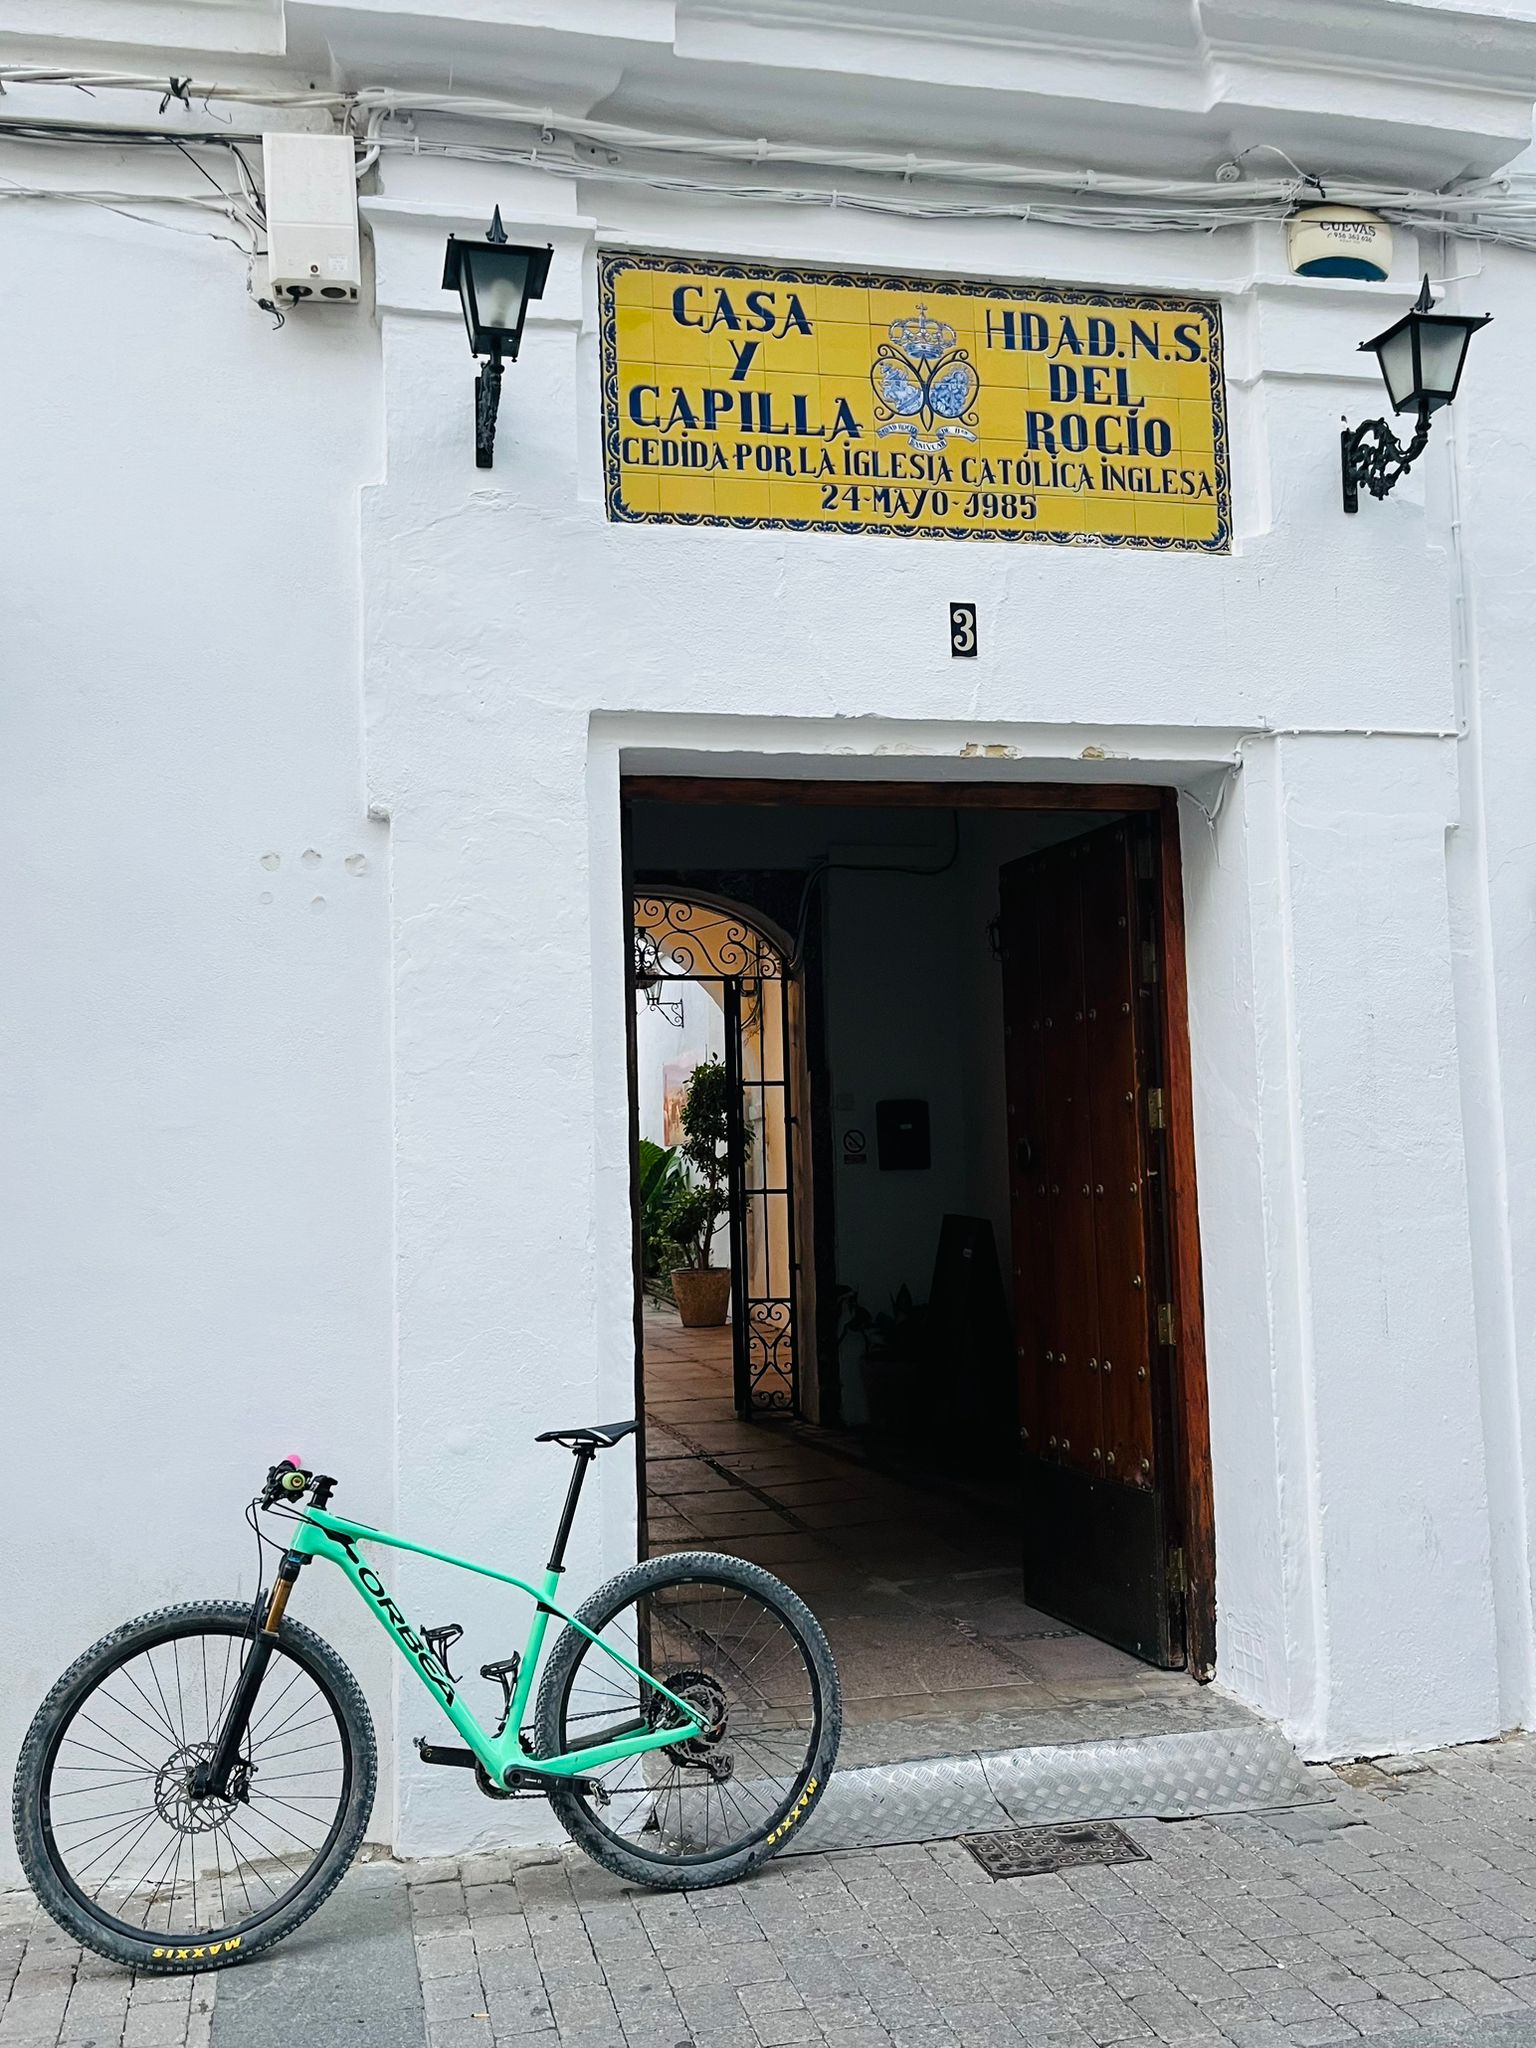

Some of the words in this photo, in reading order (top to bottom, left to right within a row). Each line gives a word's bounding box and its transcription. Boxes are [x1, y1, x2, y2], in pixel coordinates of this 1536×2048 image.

[1320, 221, 1376, 237] CUEVAS
[672, 286, 813, 339] CASA
[727, 339, 760, 381] Y
[1048, 364, 1146, 407] DEL
[629, 385, 863, 442] CAPILLA
[1025, 409, 1172, 457] ROCÍO
[733, 443, 796, 476] POR
[798, 447, 836, 478] LA
[961, 452, 1095, 492] CATÓLICA
[953, 609, 974, 651] 3
[358, 1567, 456, 1707] ORBEA
[767, 1777, 818, 1845] MAXXIS
[152, 1937, 242, 1959] MAXXIS
